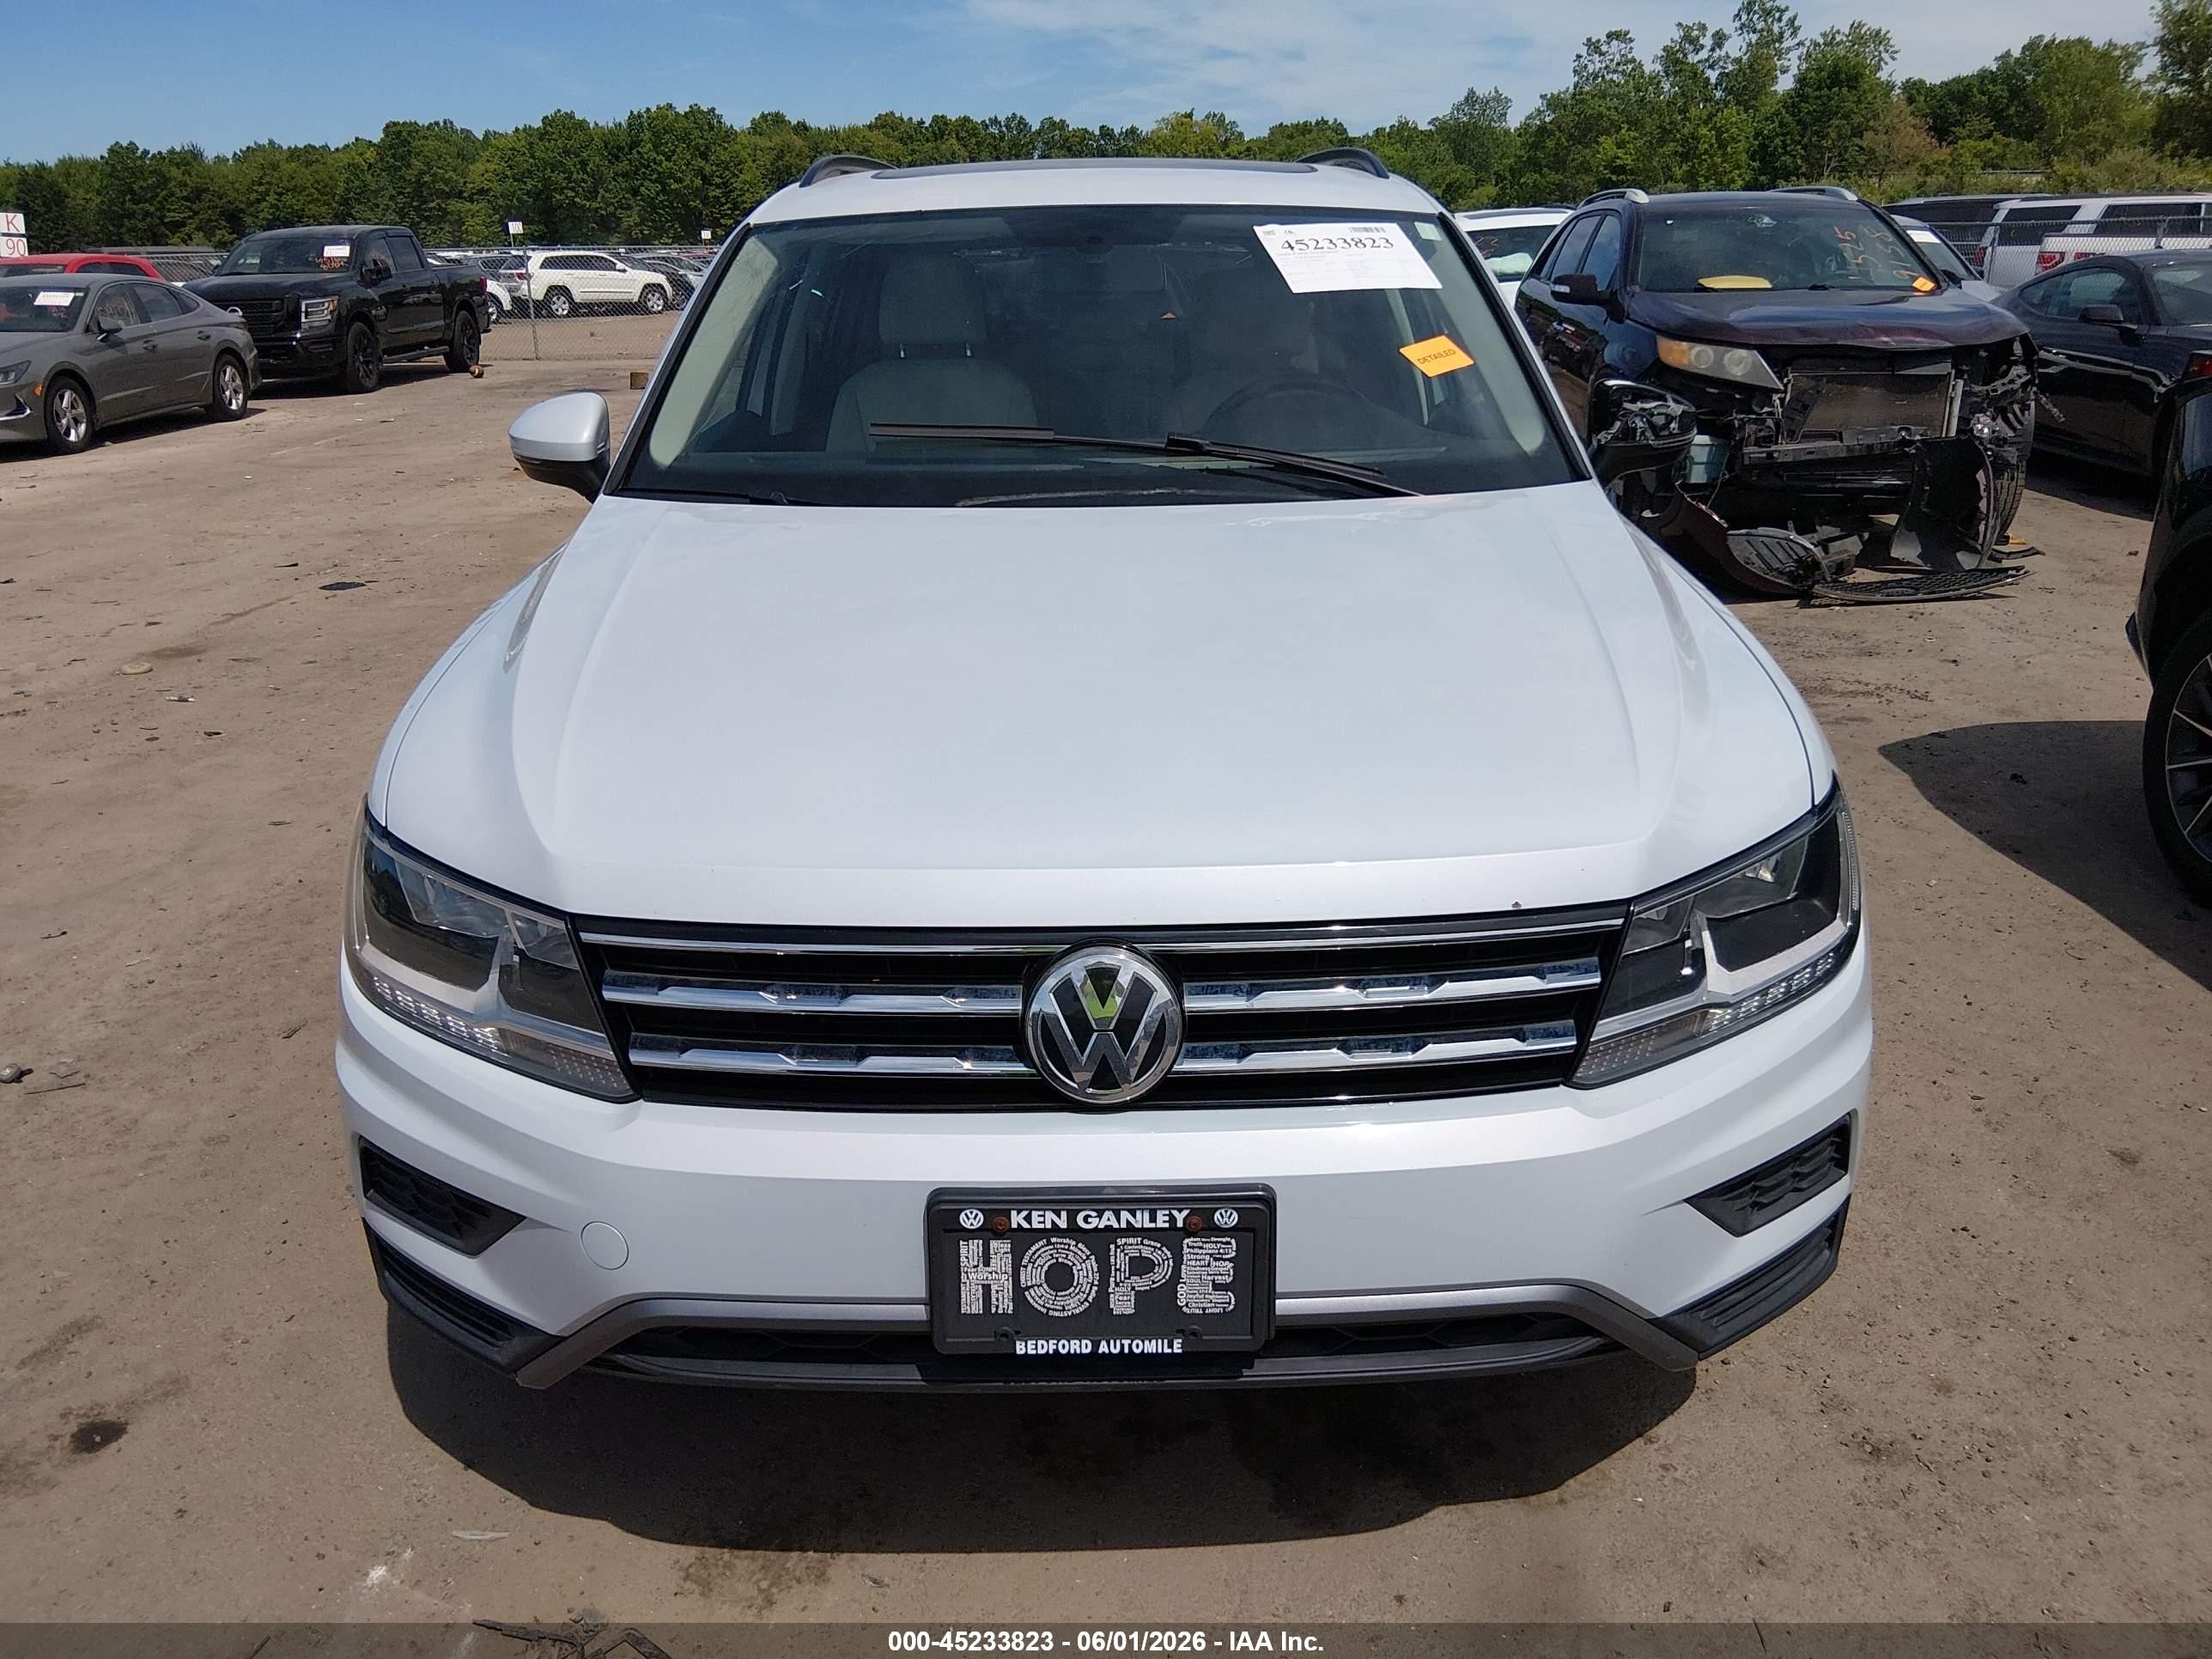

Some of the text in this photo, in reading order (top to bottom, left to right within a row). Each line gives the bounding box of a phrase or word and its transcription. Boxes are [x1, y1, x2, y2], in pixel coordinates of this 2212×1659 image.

[6, 214, 20, 232] K
[6, 238, 26, 257] 90
[1280, 237, 1394, 251] 45233823
[1417, 349, 1456, 364] DETAILED
[1011, 1208, 1191, 1229] KEN GANLEY
[959, 1237, 1237, 1316] HOPE
[968, 1272, 1008, 1282] Worship
[1176, 1283, 1186, 1306] GOD
[1016, 1339, 1182, 1354] BEDFORD AUTOMILE
